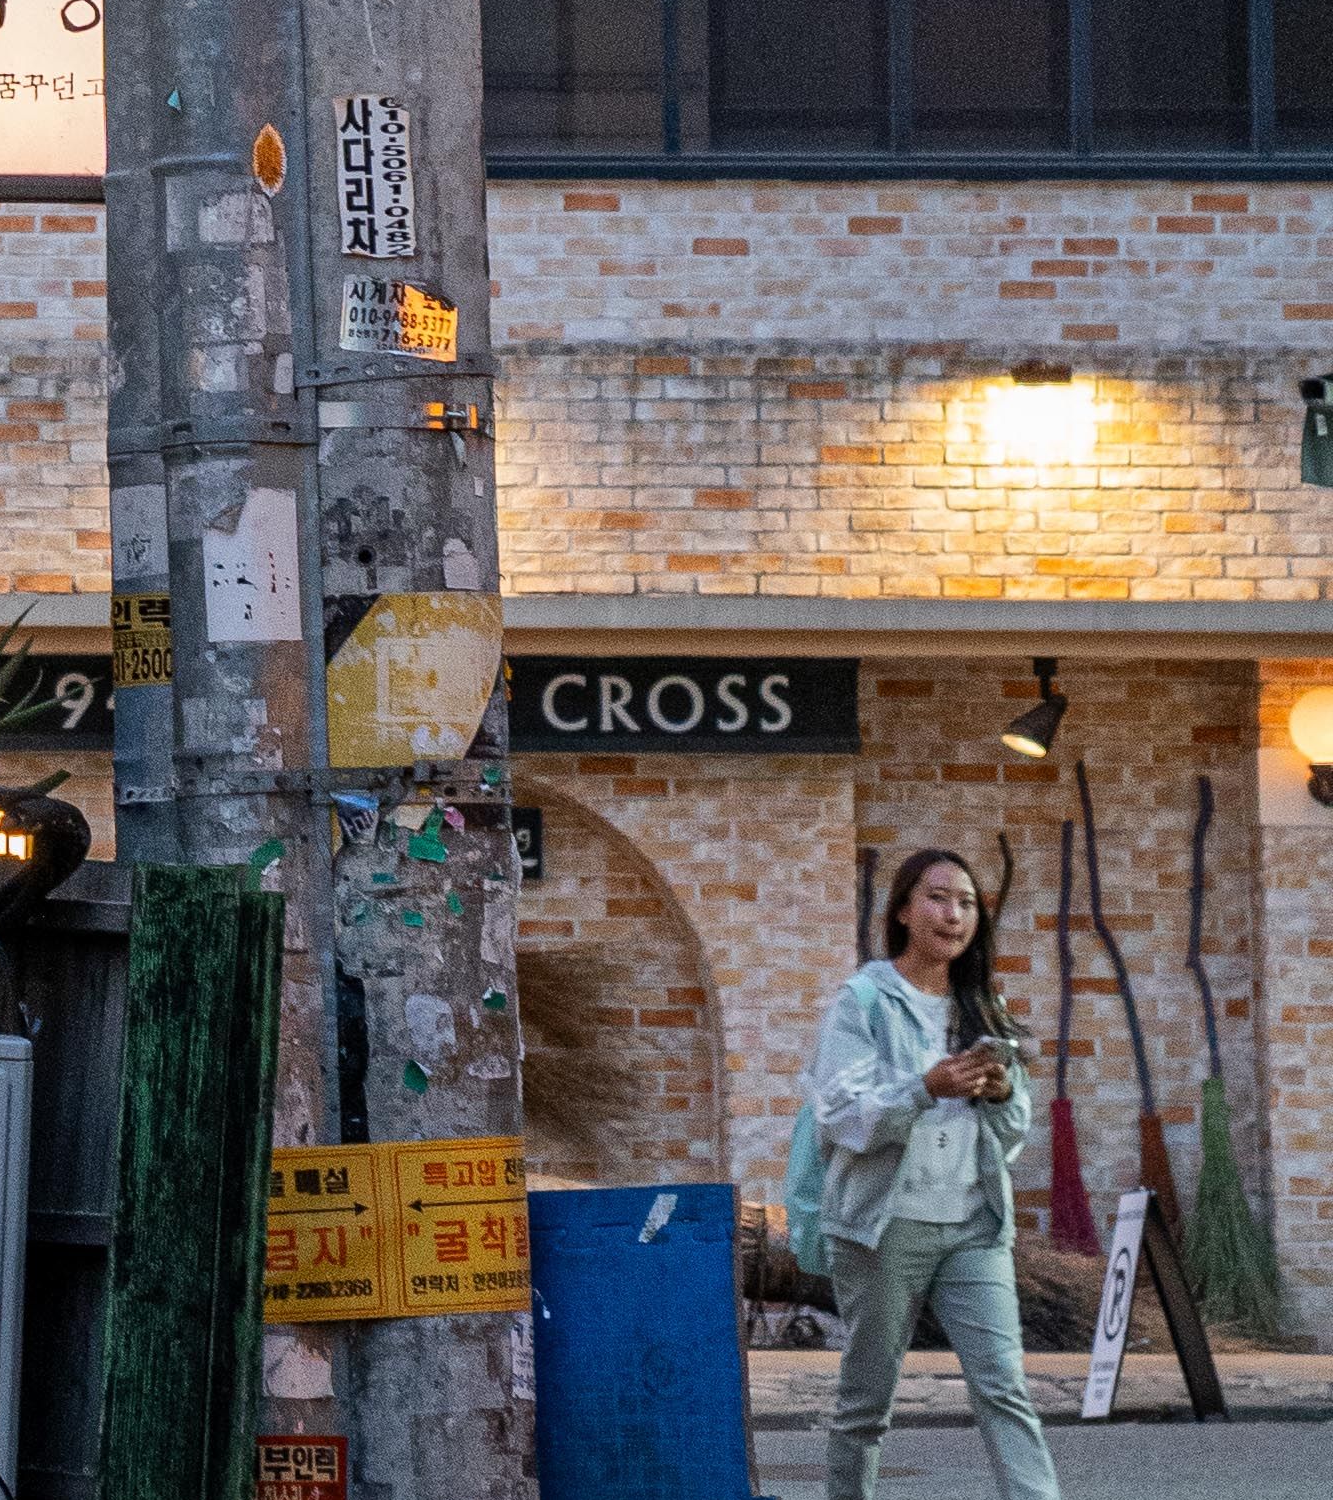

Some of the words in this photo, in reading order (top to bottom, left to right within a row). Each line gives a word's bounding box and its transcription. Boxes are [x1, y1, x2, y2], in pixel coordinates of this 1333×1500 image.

[339, 98, 379, 255] 사다리차
[541, 672, 793, 734] CROSS
[423, 1158, 497, 1189] 특고압
